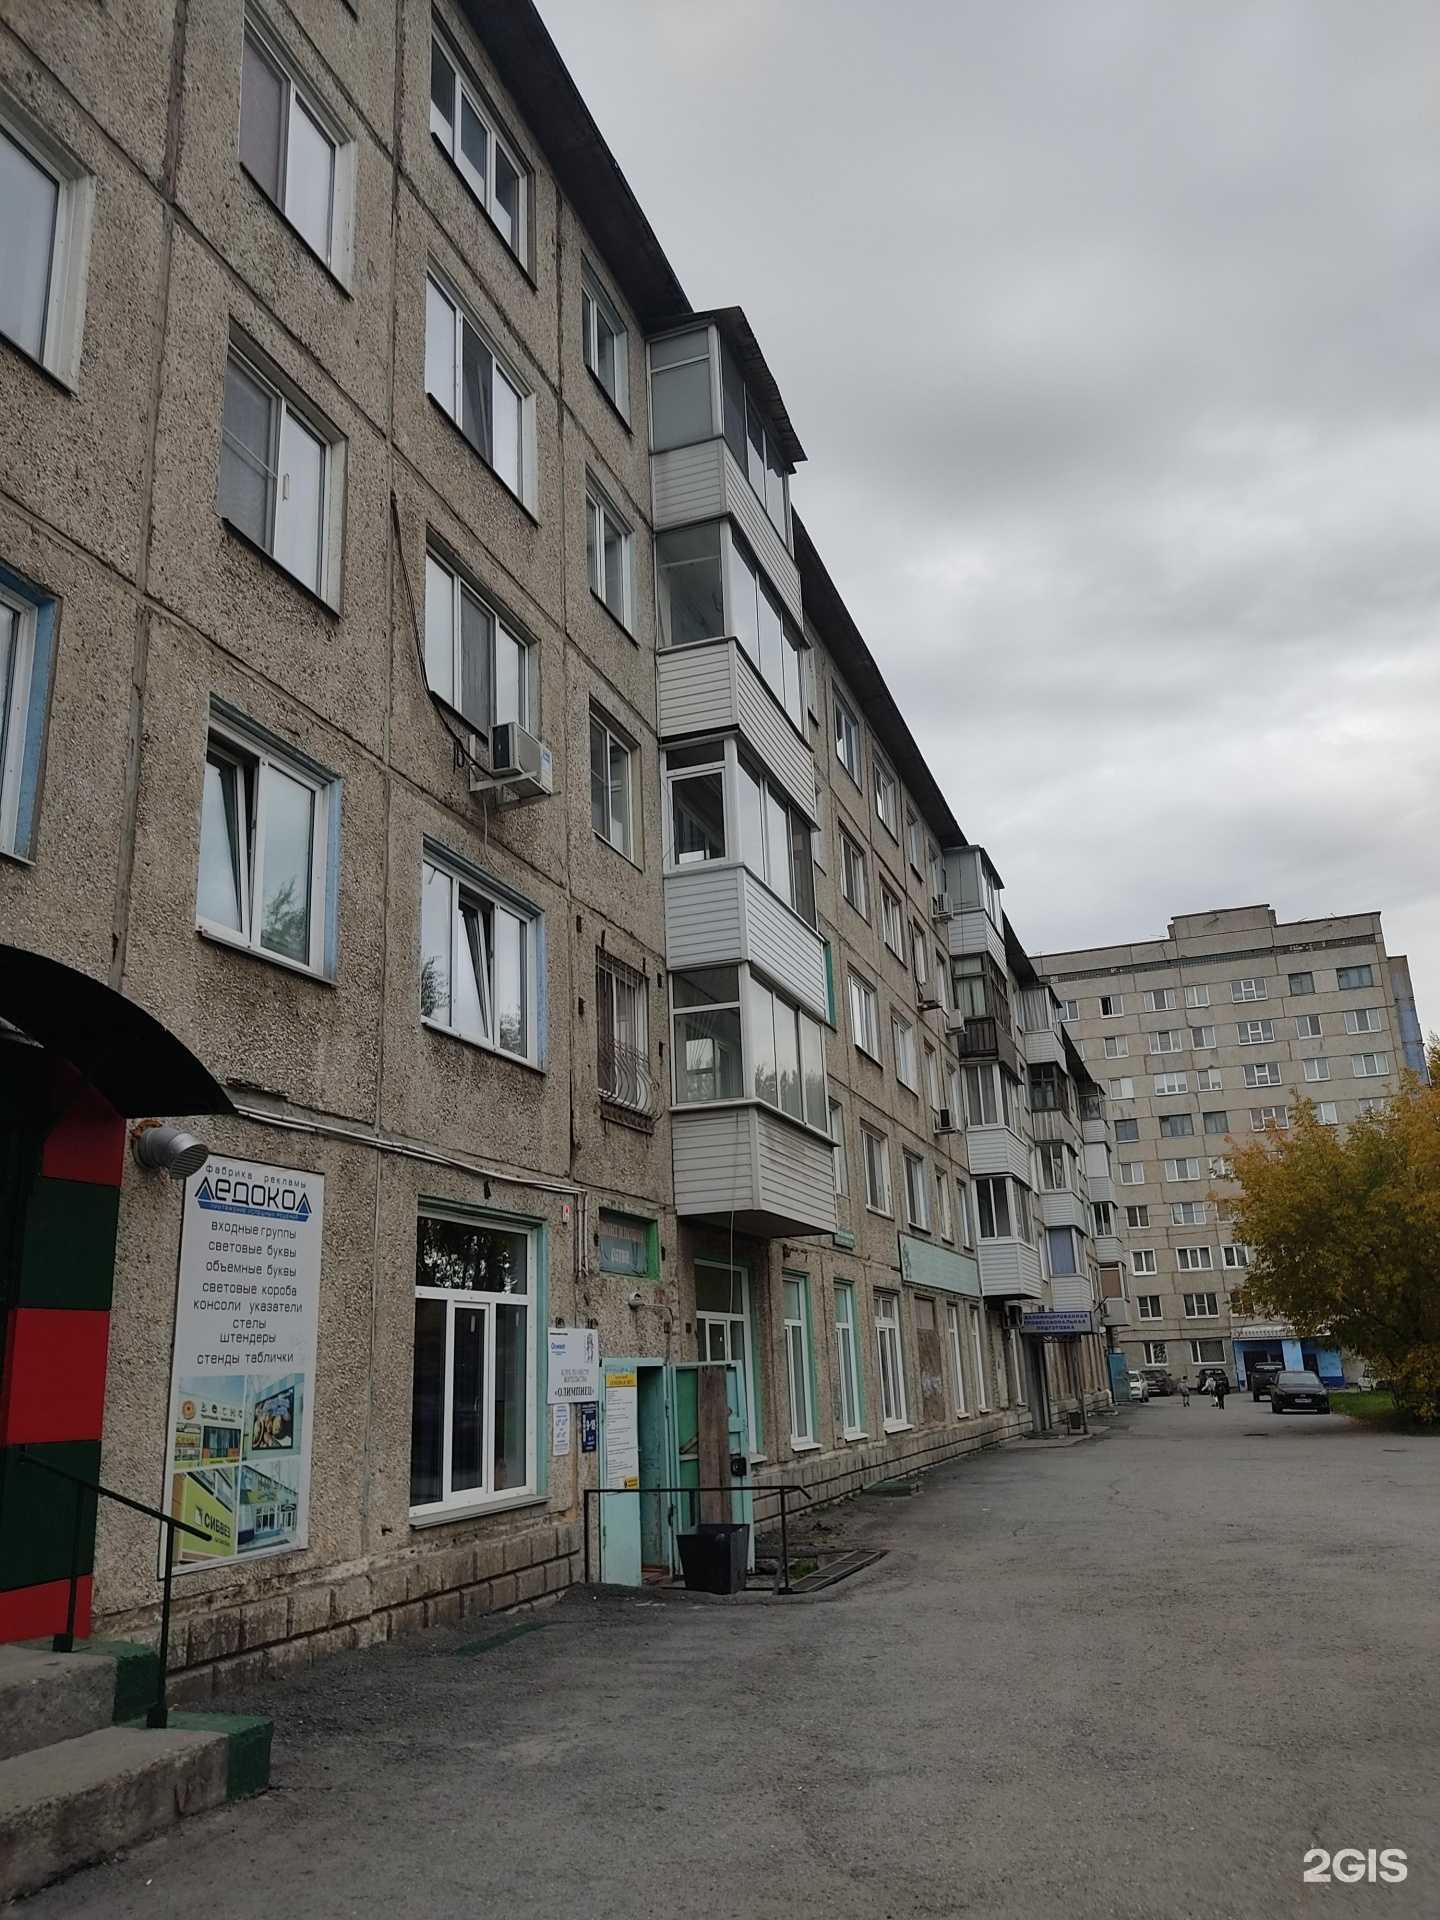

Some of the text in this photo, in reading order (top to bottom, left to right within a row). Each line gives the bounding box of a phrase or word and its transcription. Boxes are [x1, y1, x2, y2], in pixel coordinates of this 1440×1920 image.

[211, 1221, 297, 1240] входные группы
[208, 1241, 297, 1259] световые буквы
[206, 1261, 297, 1279] объемные буквы
[202, 1282, 297, 1298] световые короба
[193, 1300, 303, 1314] консоли указатели
[232, 1319, 267, 1329] стелы
[219, 1333, 277, 1345] штендеры
[196, 1351, 294, 1366] стенды таблички
